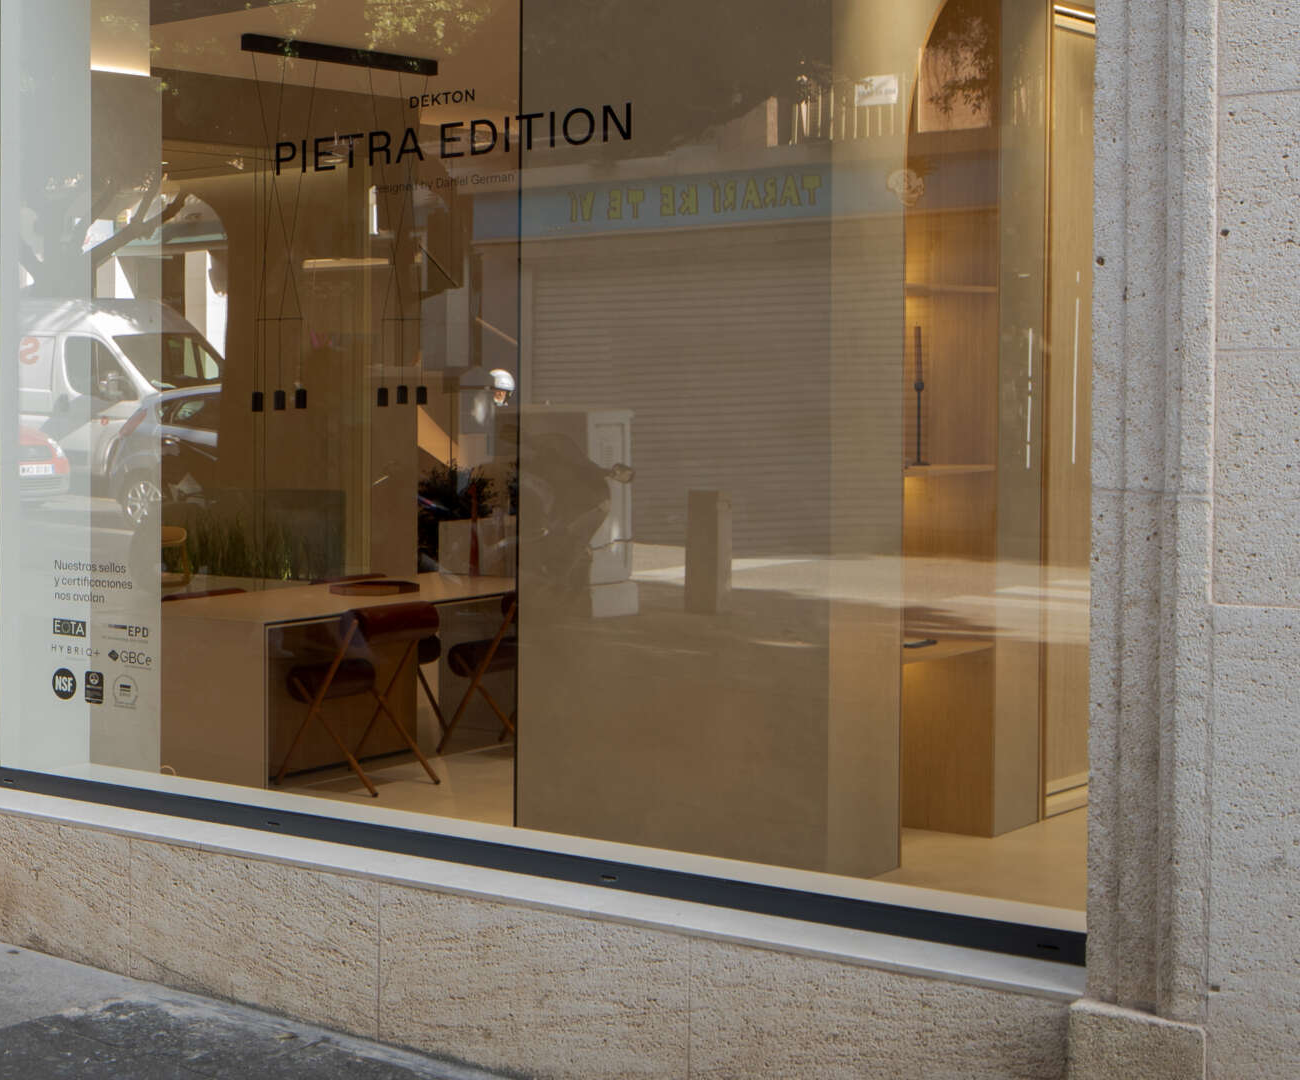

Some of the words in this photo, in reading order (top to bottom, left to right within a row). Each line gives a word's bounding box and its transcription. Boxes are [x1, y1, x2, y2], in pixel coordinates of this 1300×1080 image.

[408, 88, 476, 109] DEKTON
[275, 127, 424, 176] PIETRA
[440, 101, 632, 159] EDITION
[436, 176, 468, 189] Daniel
[471, 172, 515, 186] German
[53, 559, 98, 572] Nuestros
[99, 562, 127, 574] sellos
[53, 576, 60, 588] y
[61, 576, 133, 590] certificaciones
[54, 591, 71, 601] nos
[127, 625, 149, 638] EPD
[55, 675, 74, 693] NSF
